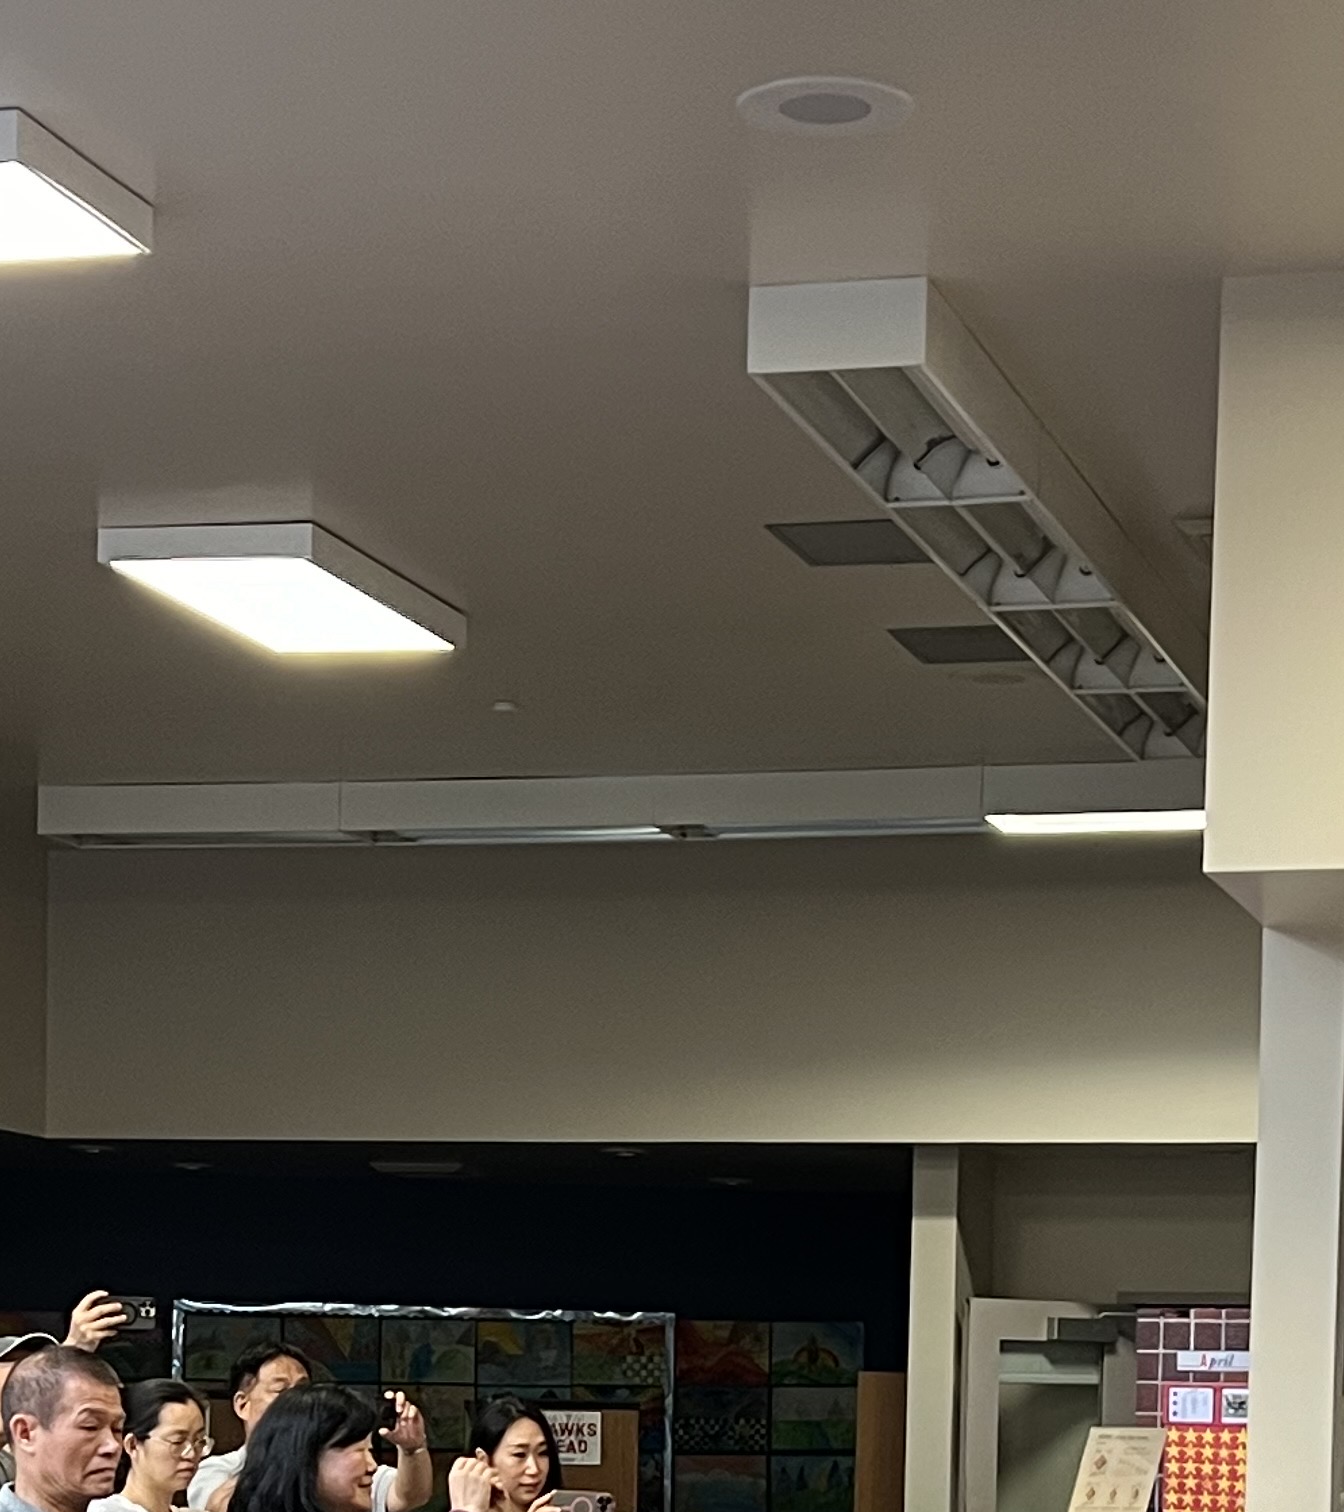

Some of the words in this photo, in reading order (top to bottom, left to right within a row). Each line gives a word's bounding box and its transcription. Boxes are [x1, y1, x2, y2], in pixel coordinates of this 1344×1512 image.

[1199, 1353, 1235, 1370] April
[550, 1423, 597, 1437] AWKS
[556, 1439, 588, 1454] EAD
